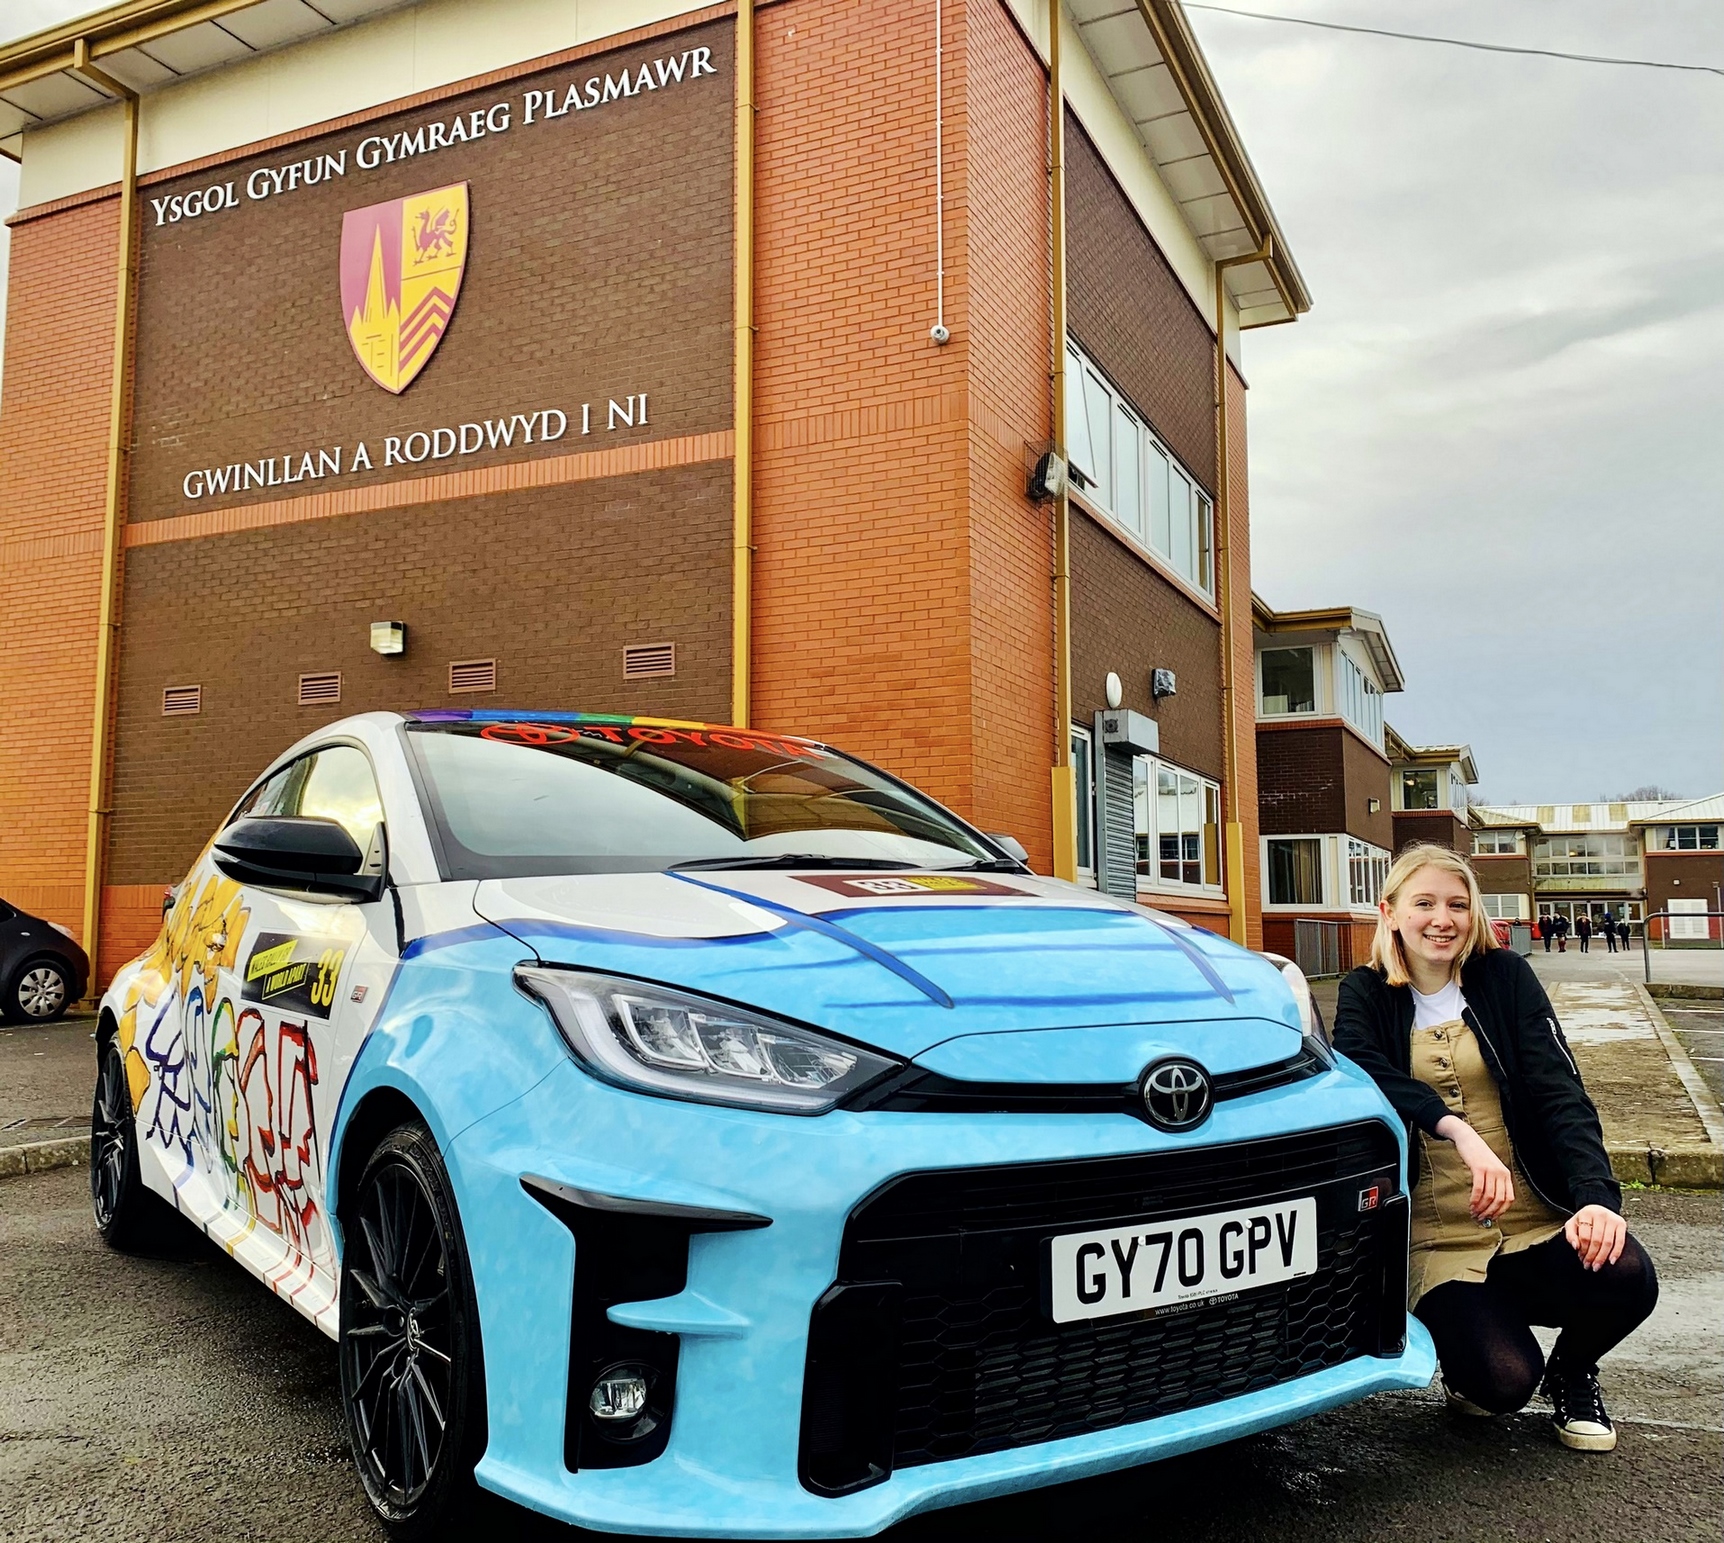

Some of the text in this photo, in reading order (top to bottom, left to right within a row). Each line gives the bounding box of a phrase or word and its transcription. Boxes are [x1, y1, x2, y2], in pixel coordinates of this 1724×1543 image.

[150, 46, 718, 226] YSGOL GYFUN GYMRAEG PLASMAWR
[182, 393, 649, 499] GWINLLAN A RODDWYD I NI
[584, 725, 826, 761] TOYOTA
[310, 947, 345, 1007] 33
[1359, 1195, 1378, 1210] GR
[1076, 1209, 1298, 1305] GY70 GPV
[1154, 1300, 1205, 1315] www.toyota.co.uk
[1218, 1293, 1240, 1303] TOYOTA
